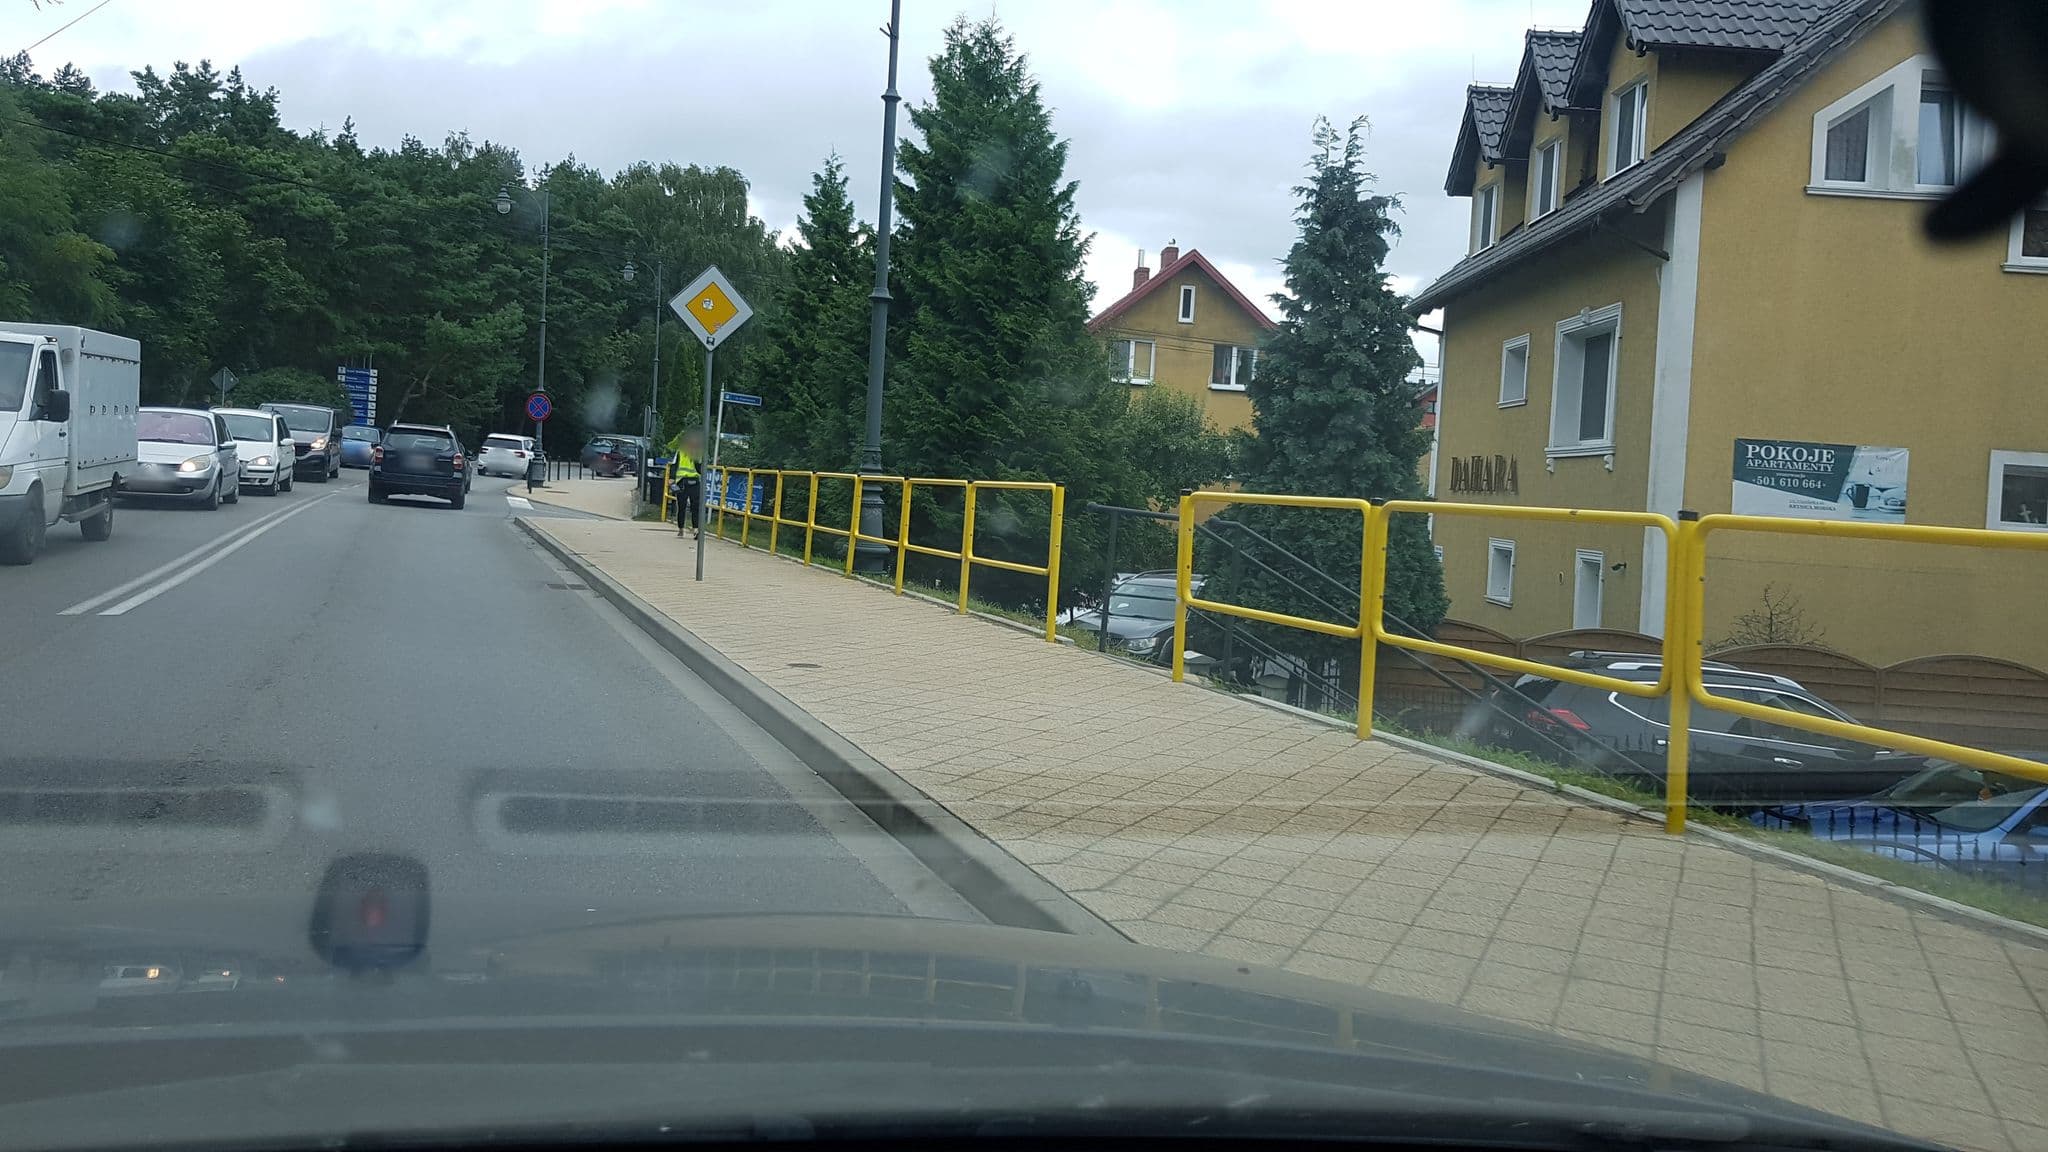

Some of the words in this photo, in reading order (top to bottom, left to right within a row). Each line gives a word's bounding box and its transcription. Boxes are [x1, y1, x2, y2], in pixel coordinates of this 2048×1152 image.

[1745, 444, 1835, 464] POKOJE
[1745, 458, 1834, 472] APARTAMENTY
[1756, 475, 1775, 486] 501
[1779, 477, 1800, 488] 610
[1802, 479, 1822, 489] 664
